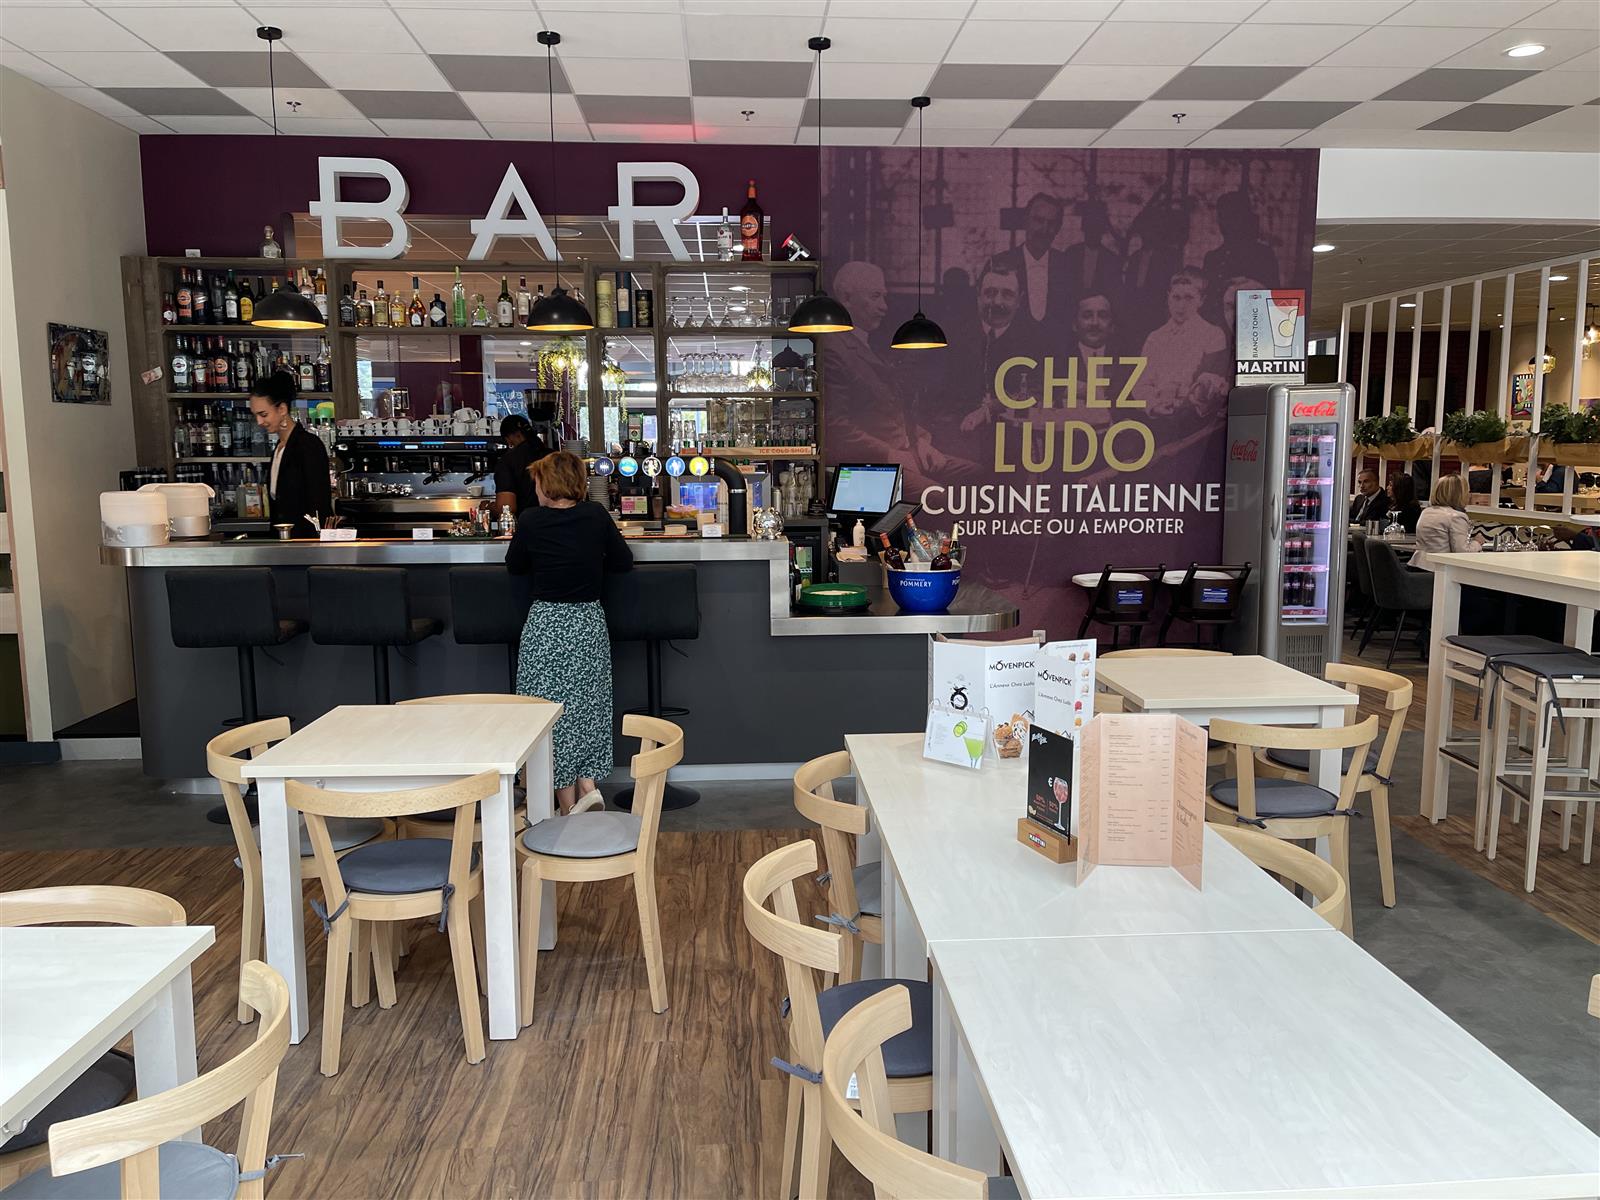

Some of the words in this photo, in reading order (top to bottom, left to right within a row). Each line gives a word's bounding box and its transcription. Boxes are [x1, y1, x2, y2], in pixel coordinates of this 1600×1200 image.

[308, 156, 702, 260] BAR
[994, 356, 1148, 410] CHEZ
[1237, 361, 1305, 373] MARTINI
[994, 420, 1156, 473] LUDO
[920, 484, 1051, 515] CUISINE
[1062, 483, 1221, 513] ITALIENNE
[957, 520, 987, 535] SUR
[992, 520, 1042, 535] PLACE
[1047, 520, 1075, 534] OU
[1080, 520, 1089, 534] A
[1094, 519, 1184, 534] EMPORTER
[1029, 833, 1046, 848] MARTINI
